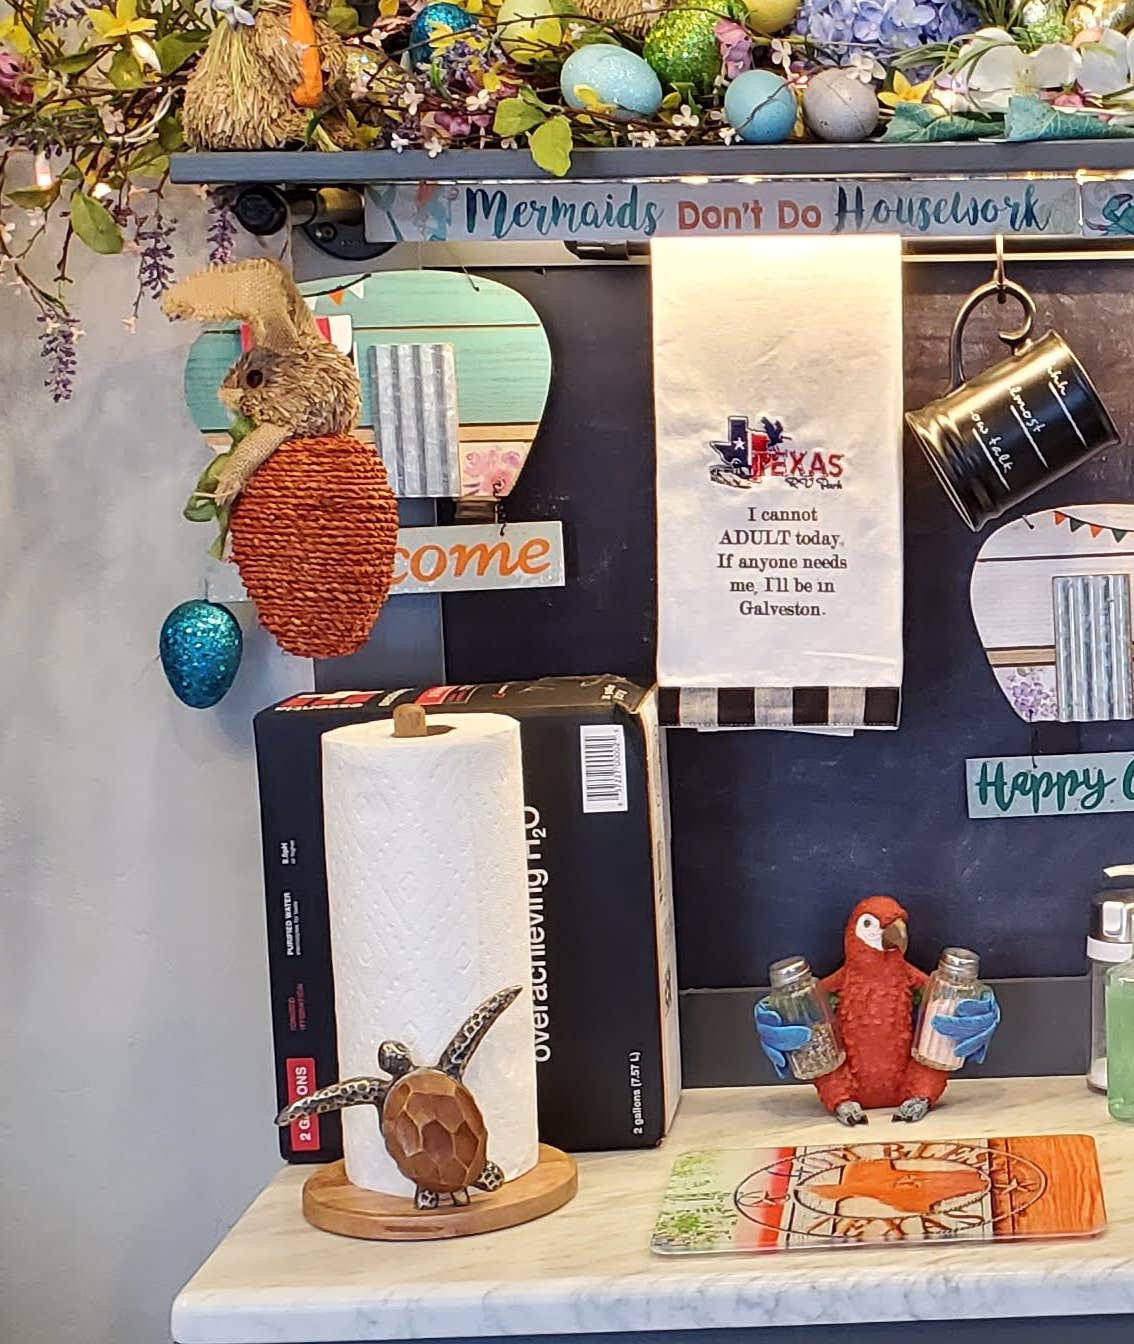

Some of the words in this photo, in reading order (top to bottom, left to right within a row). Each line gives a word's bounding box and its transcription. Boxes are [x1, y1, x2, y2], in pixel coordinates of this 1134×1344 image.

[464, 184, 665, 240] Mermaids
[677, 200, 764, 231] Don't
[776, 200, 823, 230] Do
[832, 183, 1051, 235] Housework
[752, 449, 845, 481] TEXAS
[747, 506, 757, 522] I
[761, 507, 819, 522] cannot
[718, 529, 792, 545] ADULT
[795, 530, 845, 549] today.
[716, 553, 734, 569] If
[738, 556, 798, 573] anyone
[802, 554, 848, 569] needs
[729, 580, 759, 596] me,
[764, 576, 789, 593] I'll
[794, 577, 813, 593] be
[817, 577, 836, 593] in
[739, 600, 827, 616] Galveston.
[975, 760, 1117, 813] Happy
[629, 1051, 641, 1062] L)
[630, 1064, 642, 1087] (7.57
[632, 1091, 644, 1126] gallons
[299, 1130, 312, 1142] 2
[633, 1127, 643, 1135] 2
